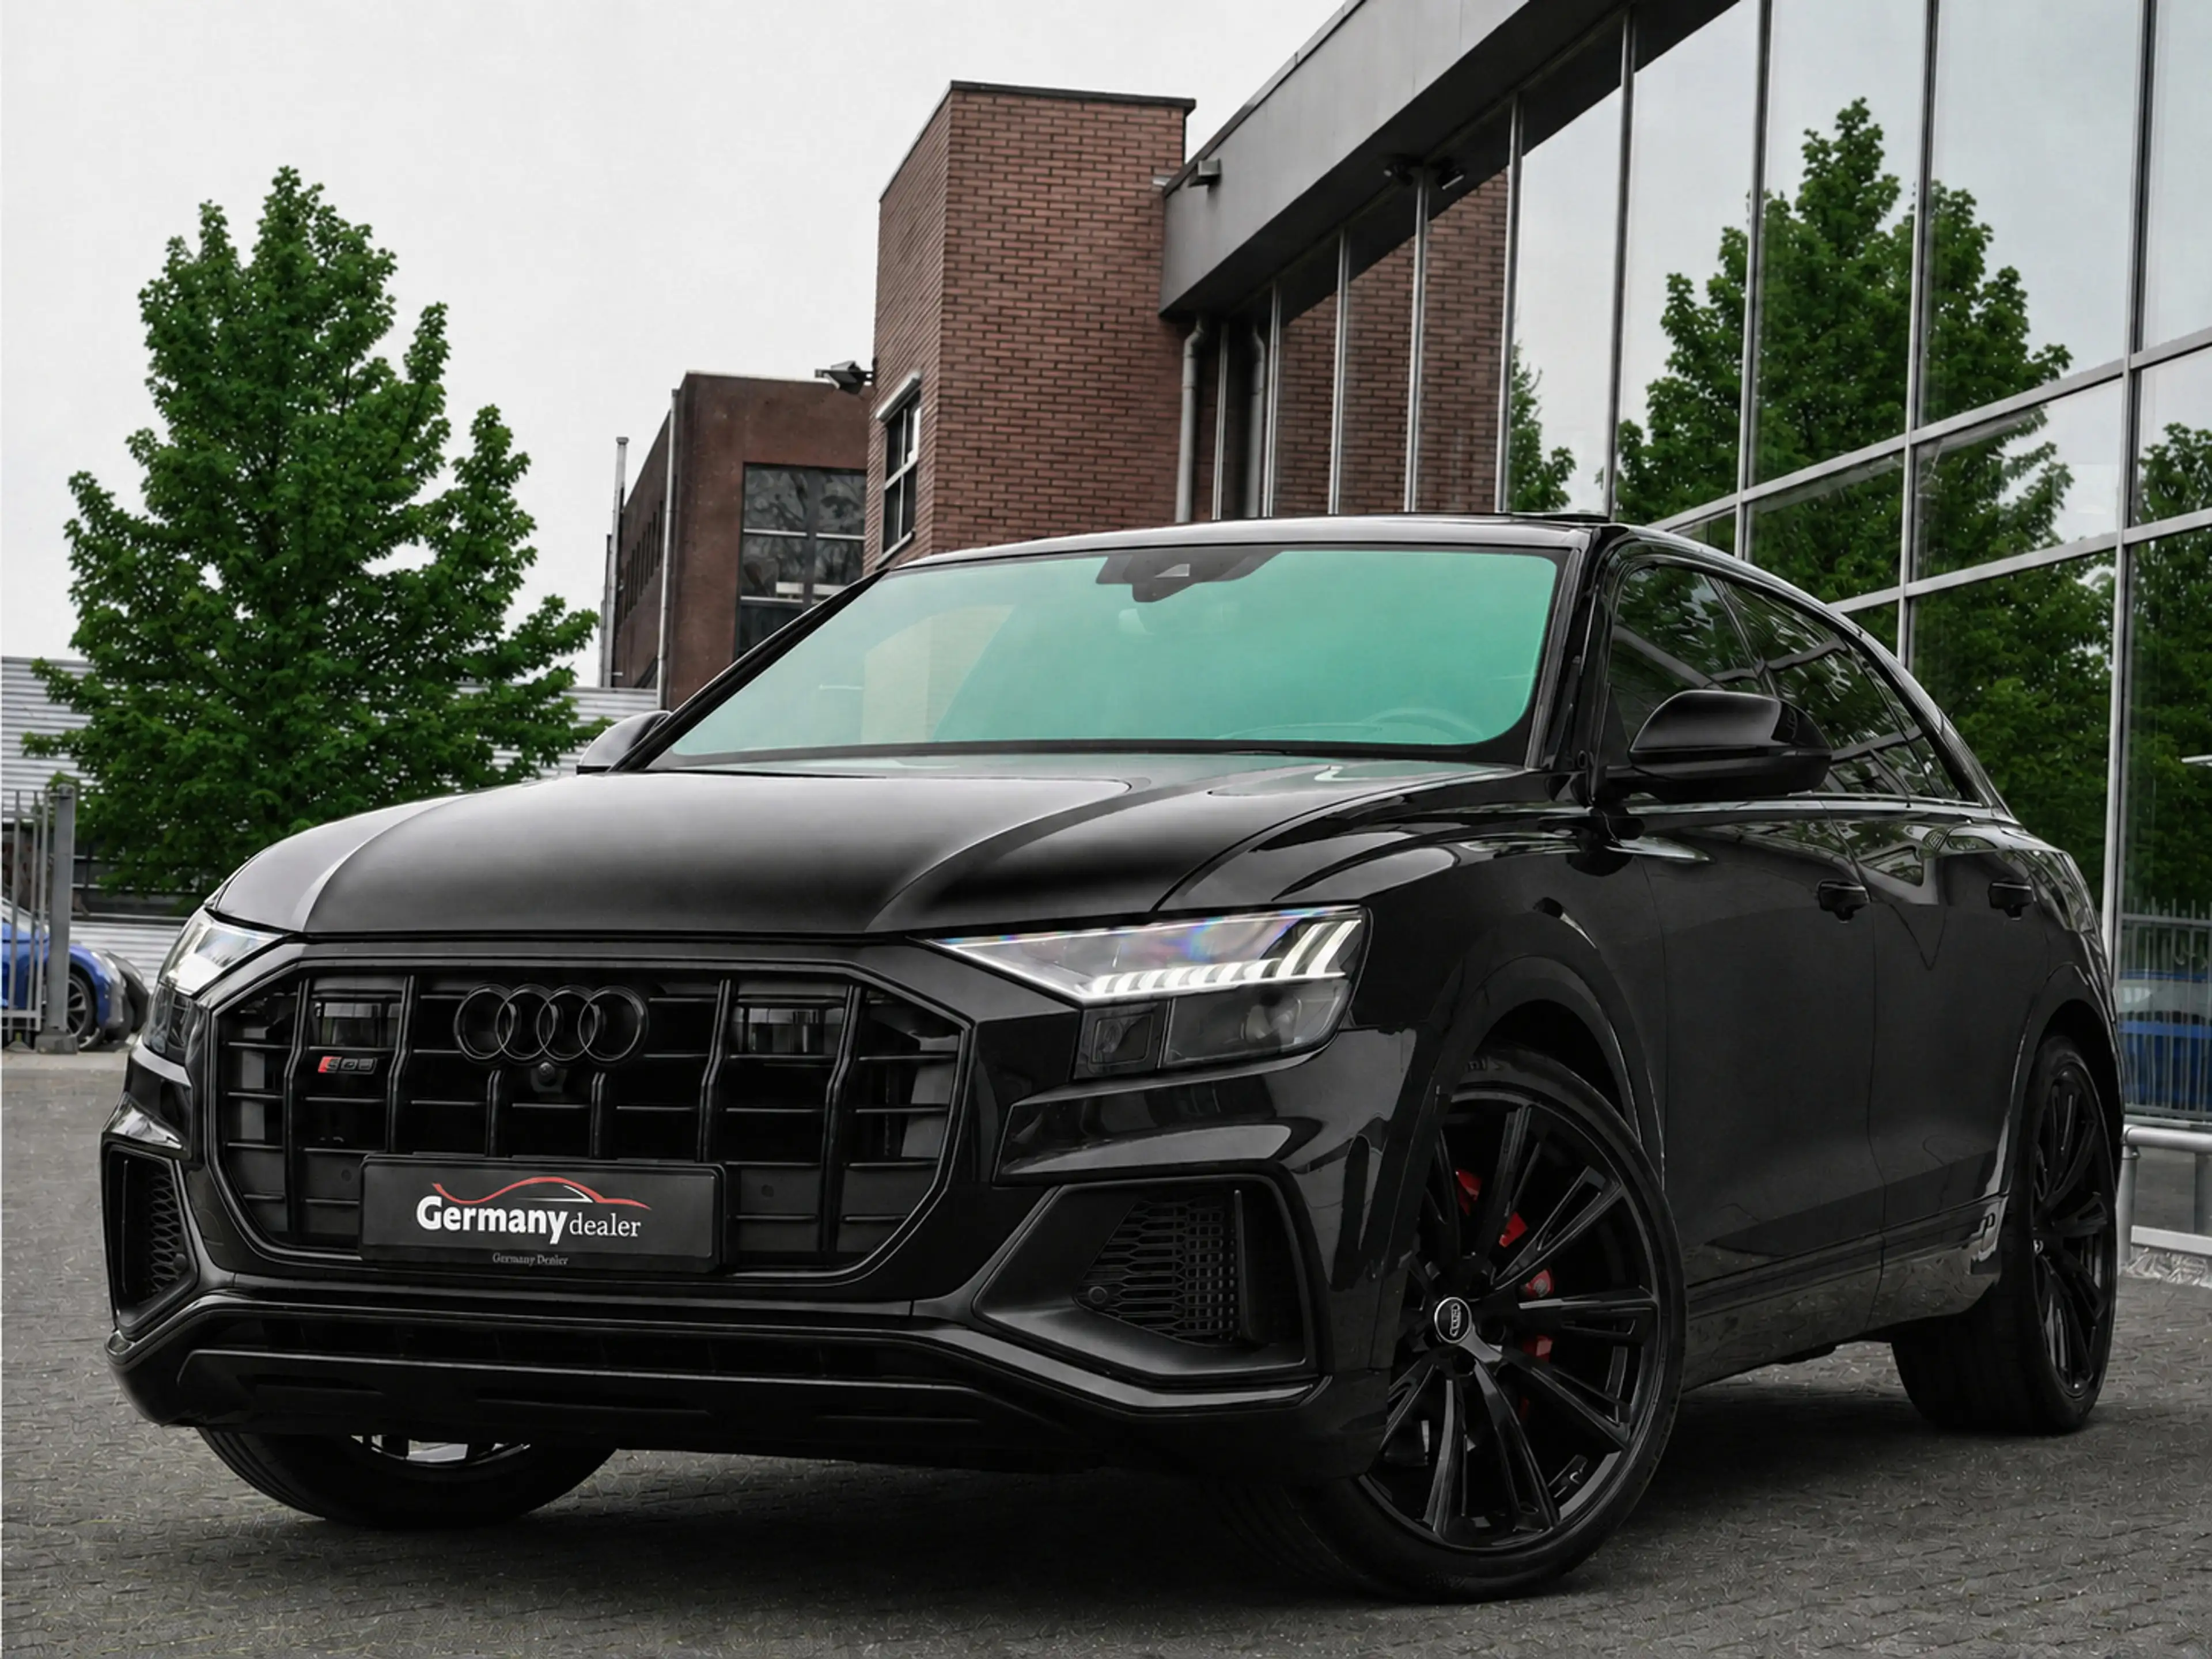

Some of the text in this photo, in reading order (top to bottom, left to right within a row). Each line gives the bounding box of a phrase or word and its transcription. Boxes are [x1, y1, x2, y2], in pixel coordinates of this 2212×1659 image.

[416, 1195, 641, 1244] Germany dealer
[493, 1252, 535, 1267] Germany
